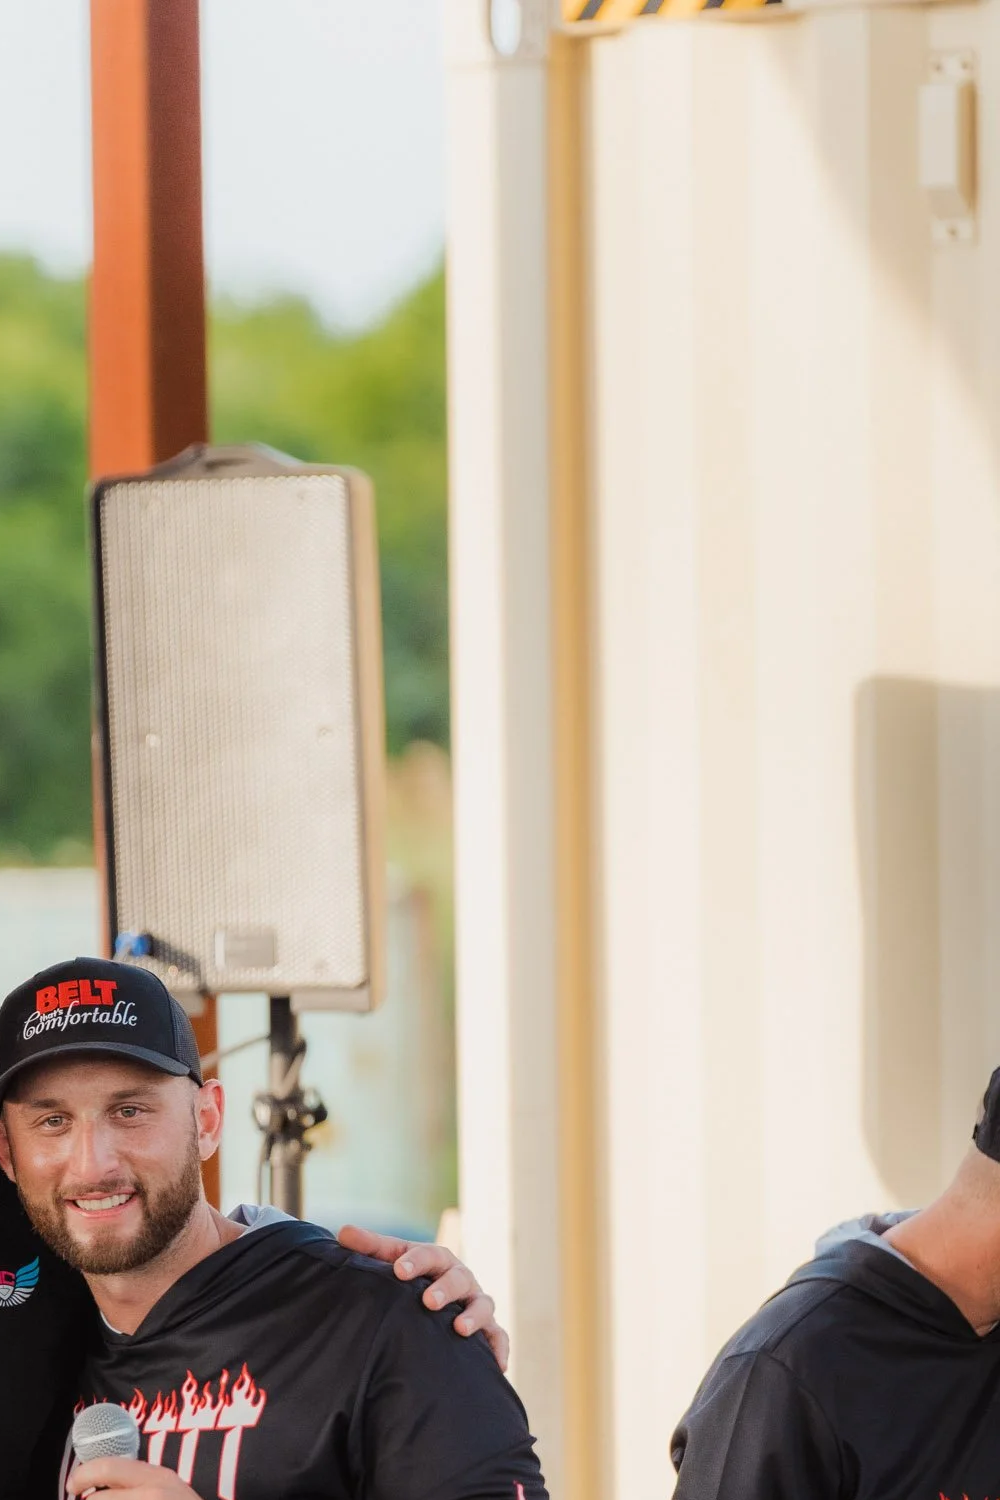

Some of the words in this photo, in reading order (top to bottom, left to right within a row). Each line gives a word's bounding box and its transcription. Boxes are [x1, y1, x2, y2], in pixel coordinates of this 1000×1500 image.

[36, 979, 117, 1014] BELT
[23, 1000, 138, 1040] Comfortable
[39, 1008, 64, 1023] that's
